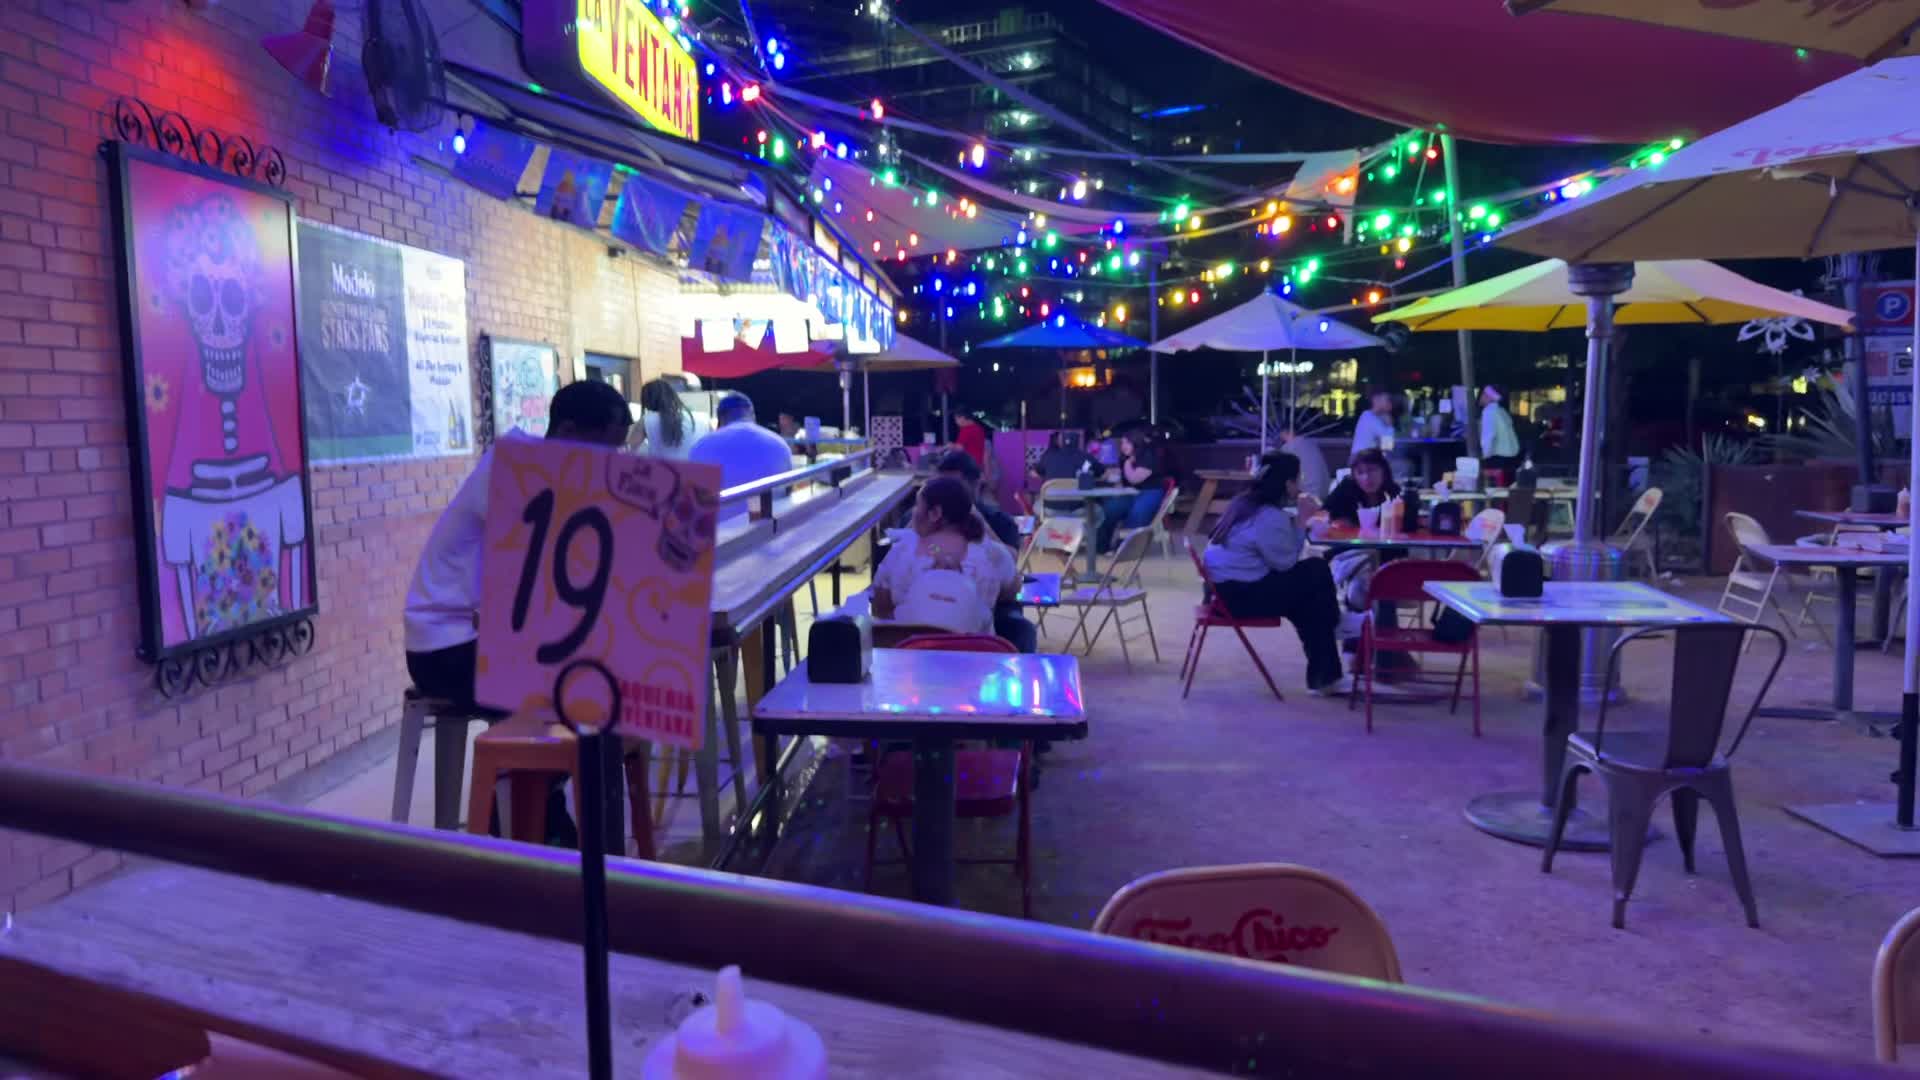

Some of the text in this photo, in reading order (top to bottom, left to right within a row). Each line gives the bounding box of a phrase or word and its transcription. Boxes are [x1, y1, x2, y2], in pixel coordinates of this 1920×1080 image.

[331, 261, 376, 298] Modelo
[511, 488, 613, 665] 19
[1233, 907, 1340, 960] Chico
